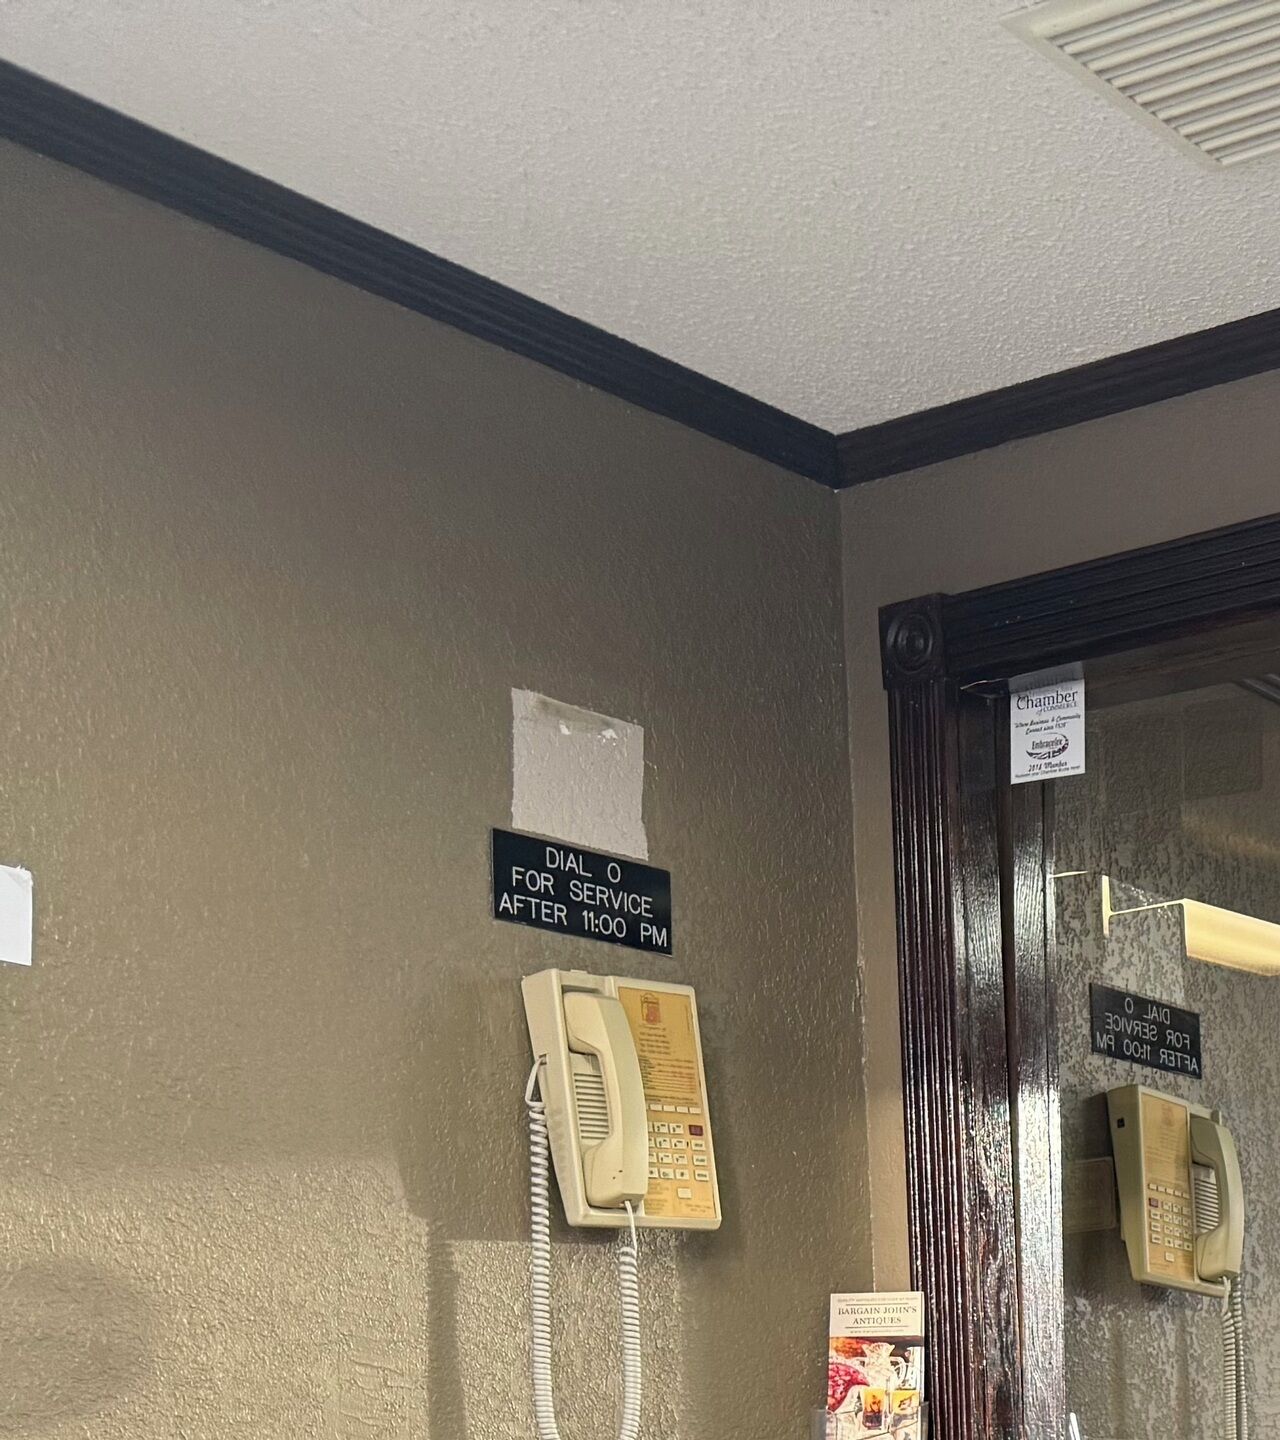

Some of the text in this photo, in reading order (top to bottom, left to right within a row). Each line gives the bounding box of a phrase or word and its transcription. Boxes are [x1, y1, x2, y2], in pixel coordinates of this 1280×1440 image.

[1016, 690, 1078, 711] Chamber
[546, 847, 592, 877] DIAL
[512, 866, 653, 918] FOR SERVICE
[499, 892, 668, 947] AFTER 11:00 PM
[838, 1305, 917, 1316] BARGAIN JOHN'S
[852, 1317, 902, 1325] ANTIQUES
